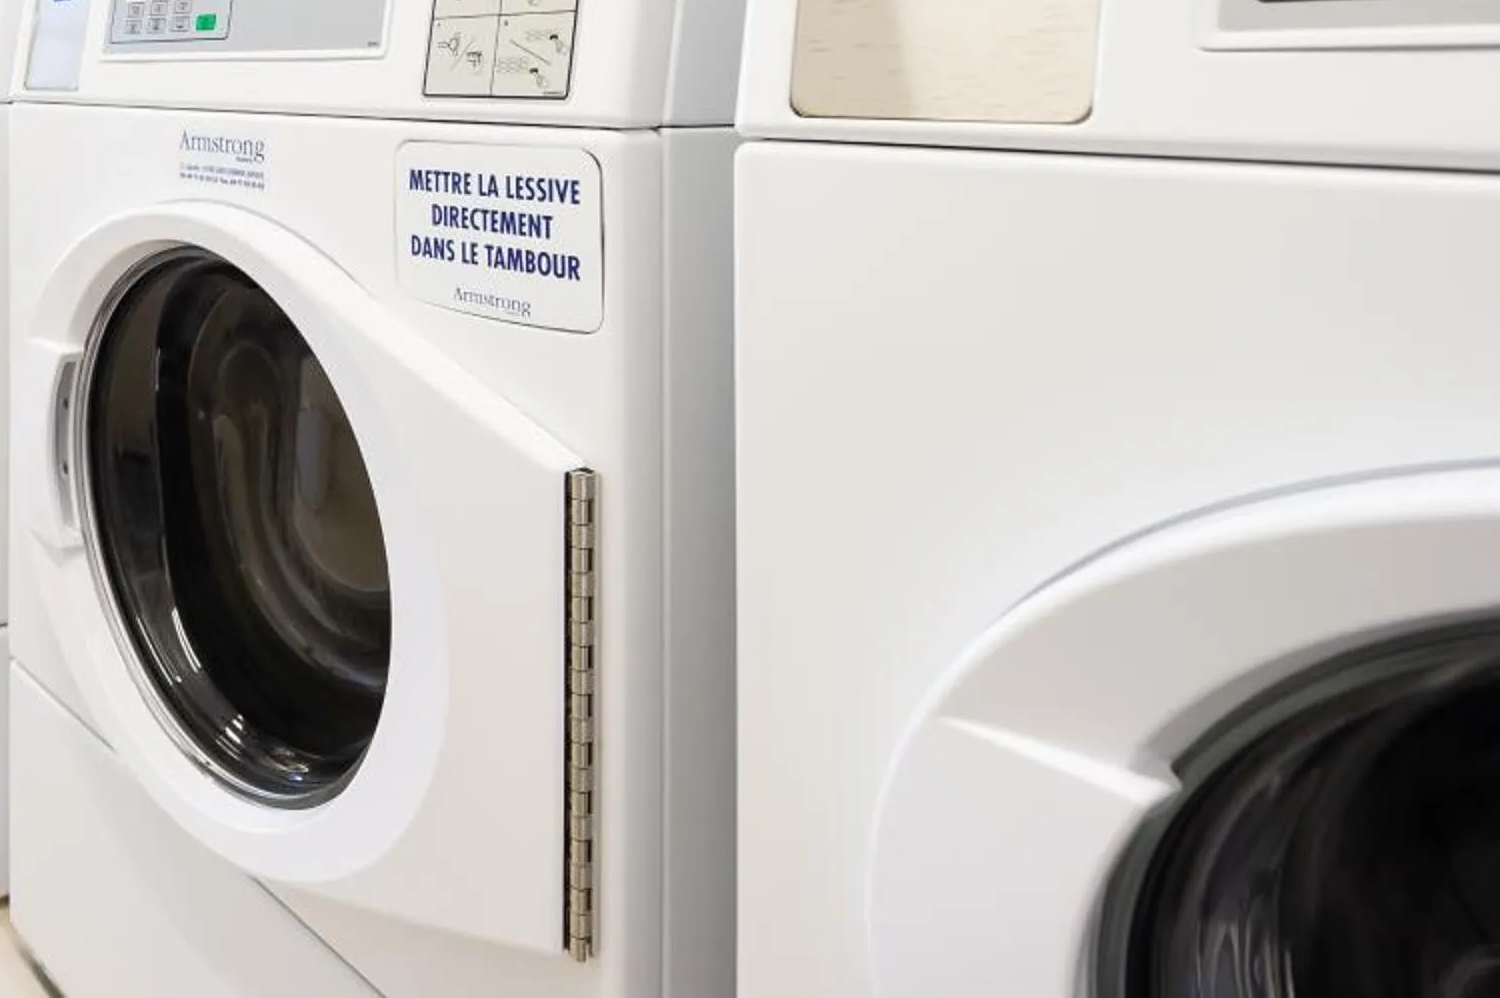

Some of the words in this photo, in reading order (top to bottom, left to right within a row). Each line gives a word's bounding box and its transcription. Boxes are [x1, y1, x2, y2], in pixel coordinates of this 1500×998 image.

[180, 129, 265, 162] Armstrong
[409, 168, 472, 196] METTRE
[478, 173, 499, 198] LA
[505, 175, 581, 205] LESSIVE
[431, 203, 554, 240] DIRECTEMENT
[410, 234, 456, 262] DANS
[461, 241, 479, 266] LE
[484, 243, 581, 282] TAMBOUR
[453, 287, 532, 318] Armstrong
